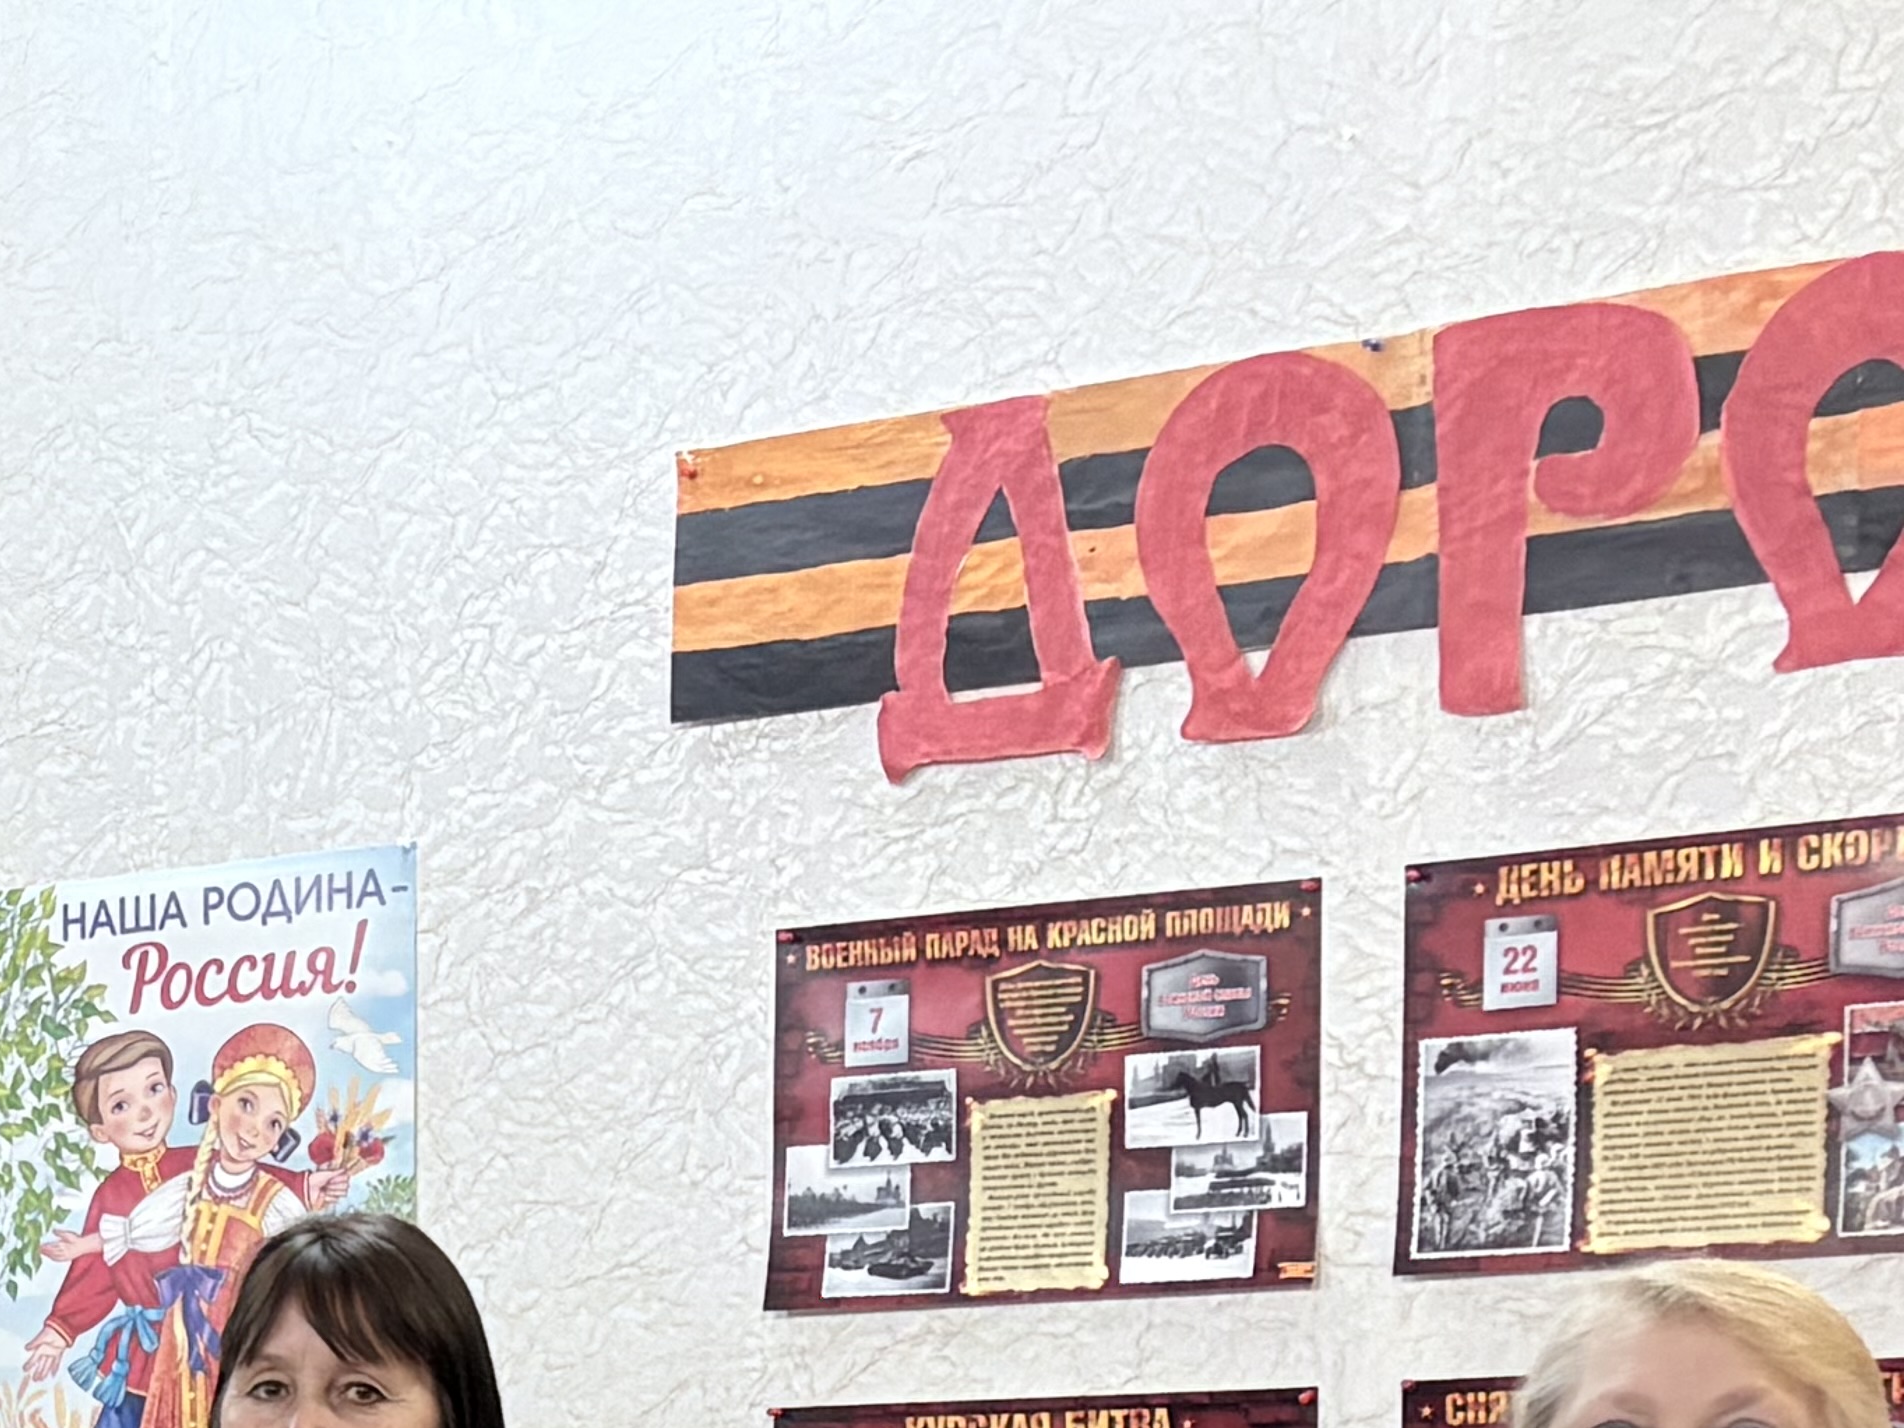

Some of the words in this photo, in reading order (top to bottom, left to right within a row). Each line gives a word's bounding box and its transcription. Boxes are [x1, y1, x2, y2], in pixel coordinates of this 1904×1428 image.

[1495, 863, 1585, 906] ДЕНЬ
[1598, 844, 1744, 891] ПАМЯТИ
[1759, 837, 1783, 875] И
[62, 891, 188, 942] НАША
[805, 933, 916, 972] ВОЕННЫЙ
[925, 926, 1001, 961] ПАРАД
[1008, 926, 1039, 953] НА
[1047, 908, 1157, 948] КРАСНОЙ
[1165, 901, 1291, 939] ПЛОЩАДИ
[122, 918, 369, 1014] Россия!
[1503, 944, 1538, 976] 22
[869, 1007, 884, 1035] 7
[1445, 1390, 1508, 1427] СНЯ
